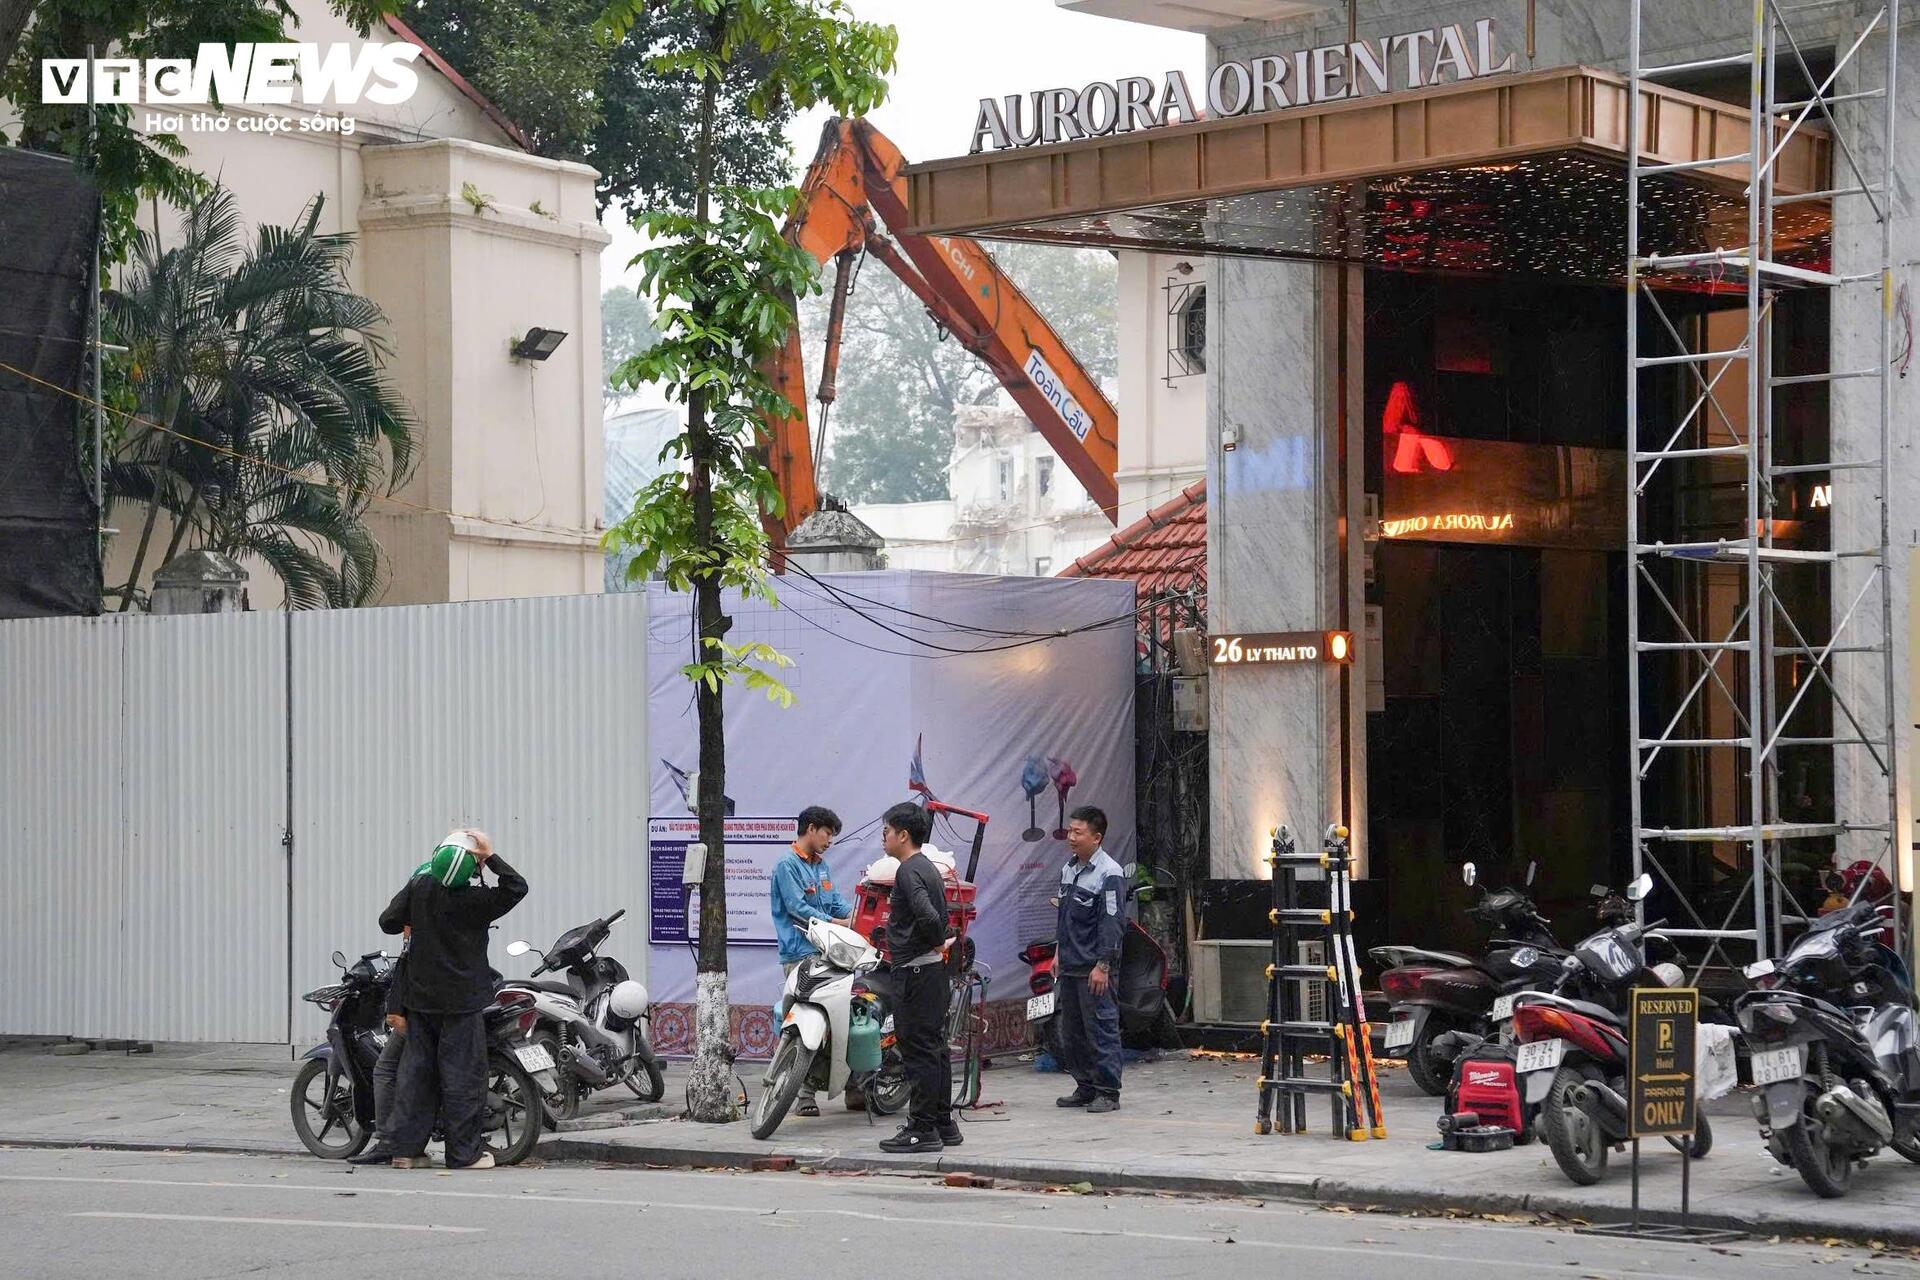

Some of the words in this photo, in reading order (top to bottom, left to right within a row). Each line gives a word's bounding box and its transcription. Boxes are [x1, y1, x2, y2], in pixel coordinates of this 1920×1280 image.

[969, 70, 1197, 154] AURORA
[1209, 18, 1512, 118] ORIENTAL
[939, 238, 975, 280] ACHI
[1029, 355, 1062, 407] Toàn
[1061, 398, 1088, 439] Cầu
[1214, 637, 1242, 663] 26
[1246, 648, 1262, 662] LY
[1264, 647, 1296, 661] THAI
[1297, 646, 1317, 660] TO
[1639, 999, 1693, 1015] RESERVED
[1643, 1086, 1686, 1098] PARKING
[1643, 1101, 1685, 1126] ONLY
